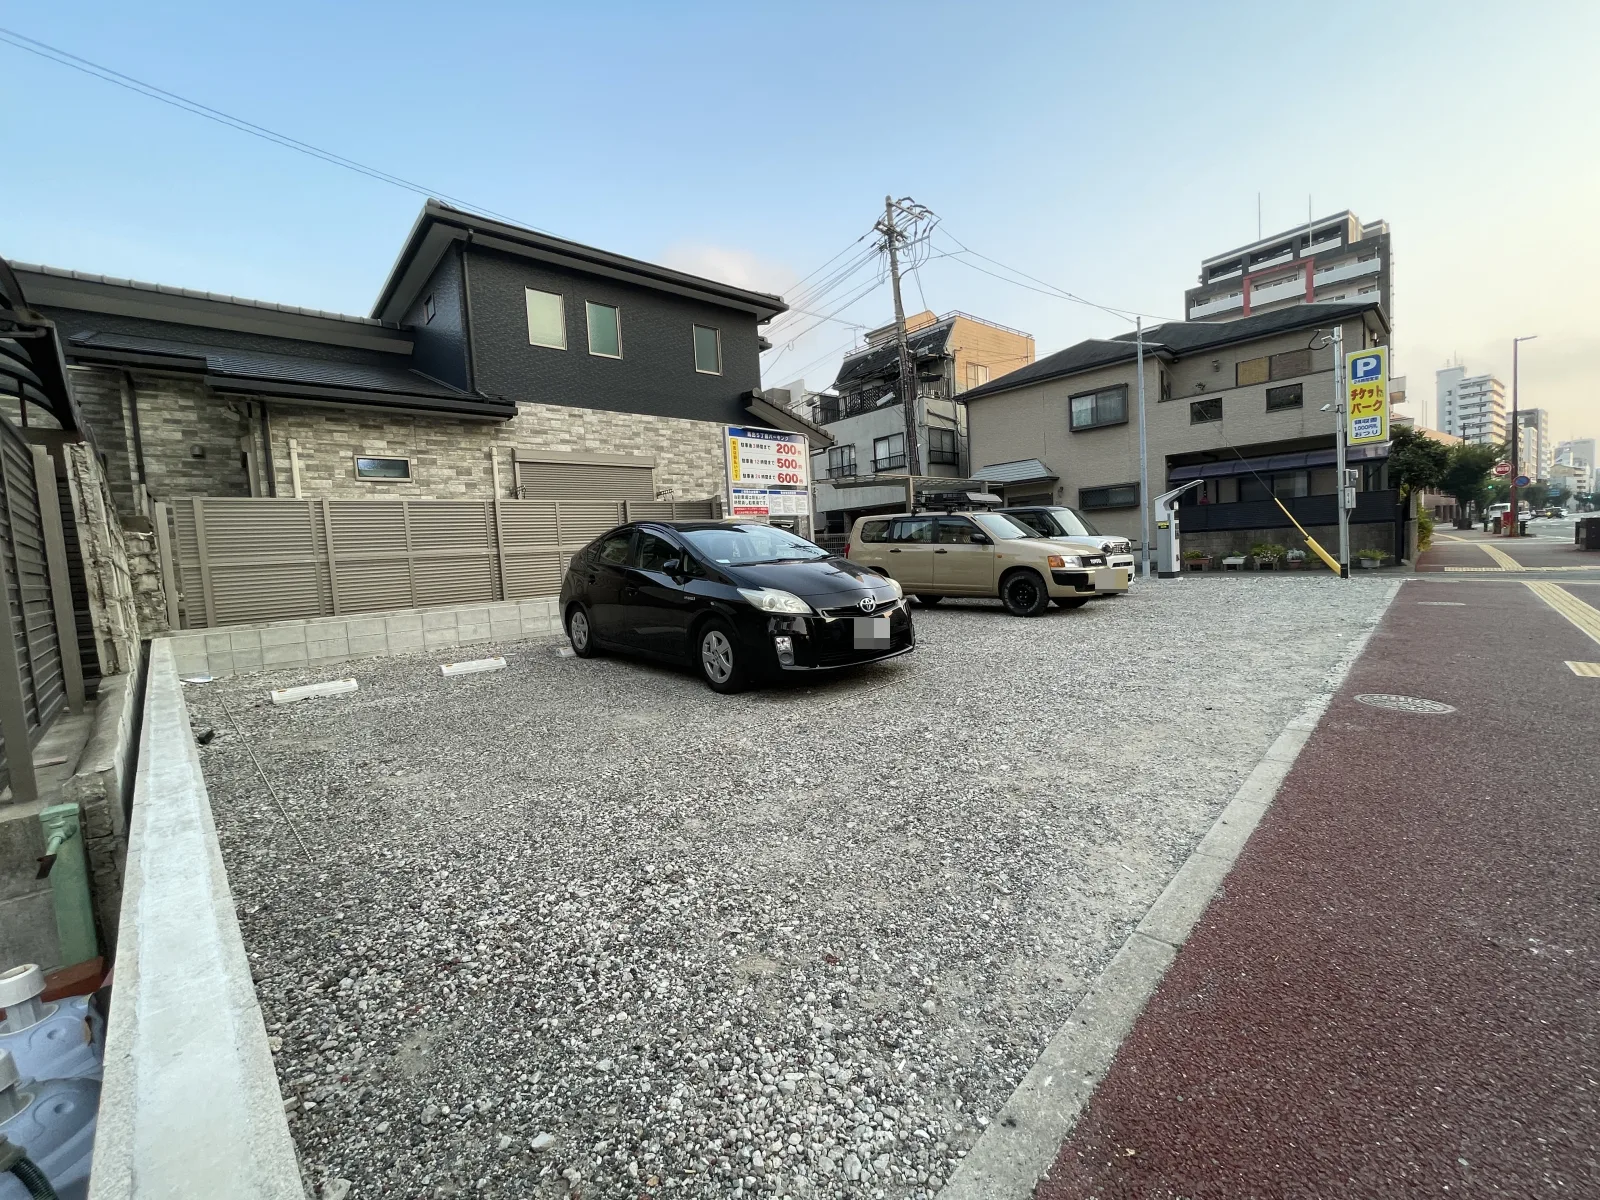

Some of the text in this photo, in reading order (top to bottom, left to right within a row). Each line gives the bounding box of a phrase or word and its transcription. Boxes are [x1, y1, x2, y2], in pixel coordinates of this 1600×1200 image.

[1356, 357, 1377, 377] P
[1350, 385, 1383, 401] チケット
